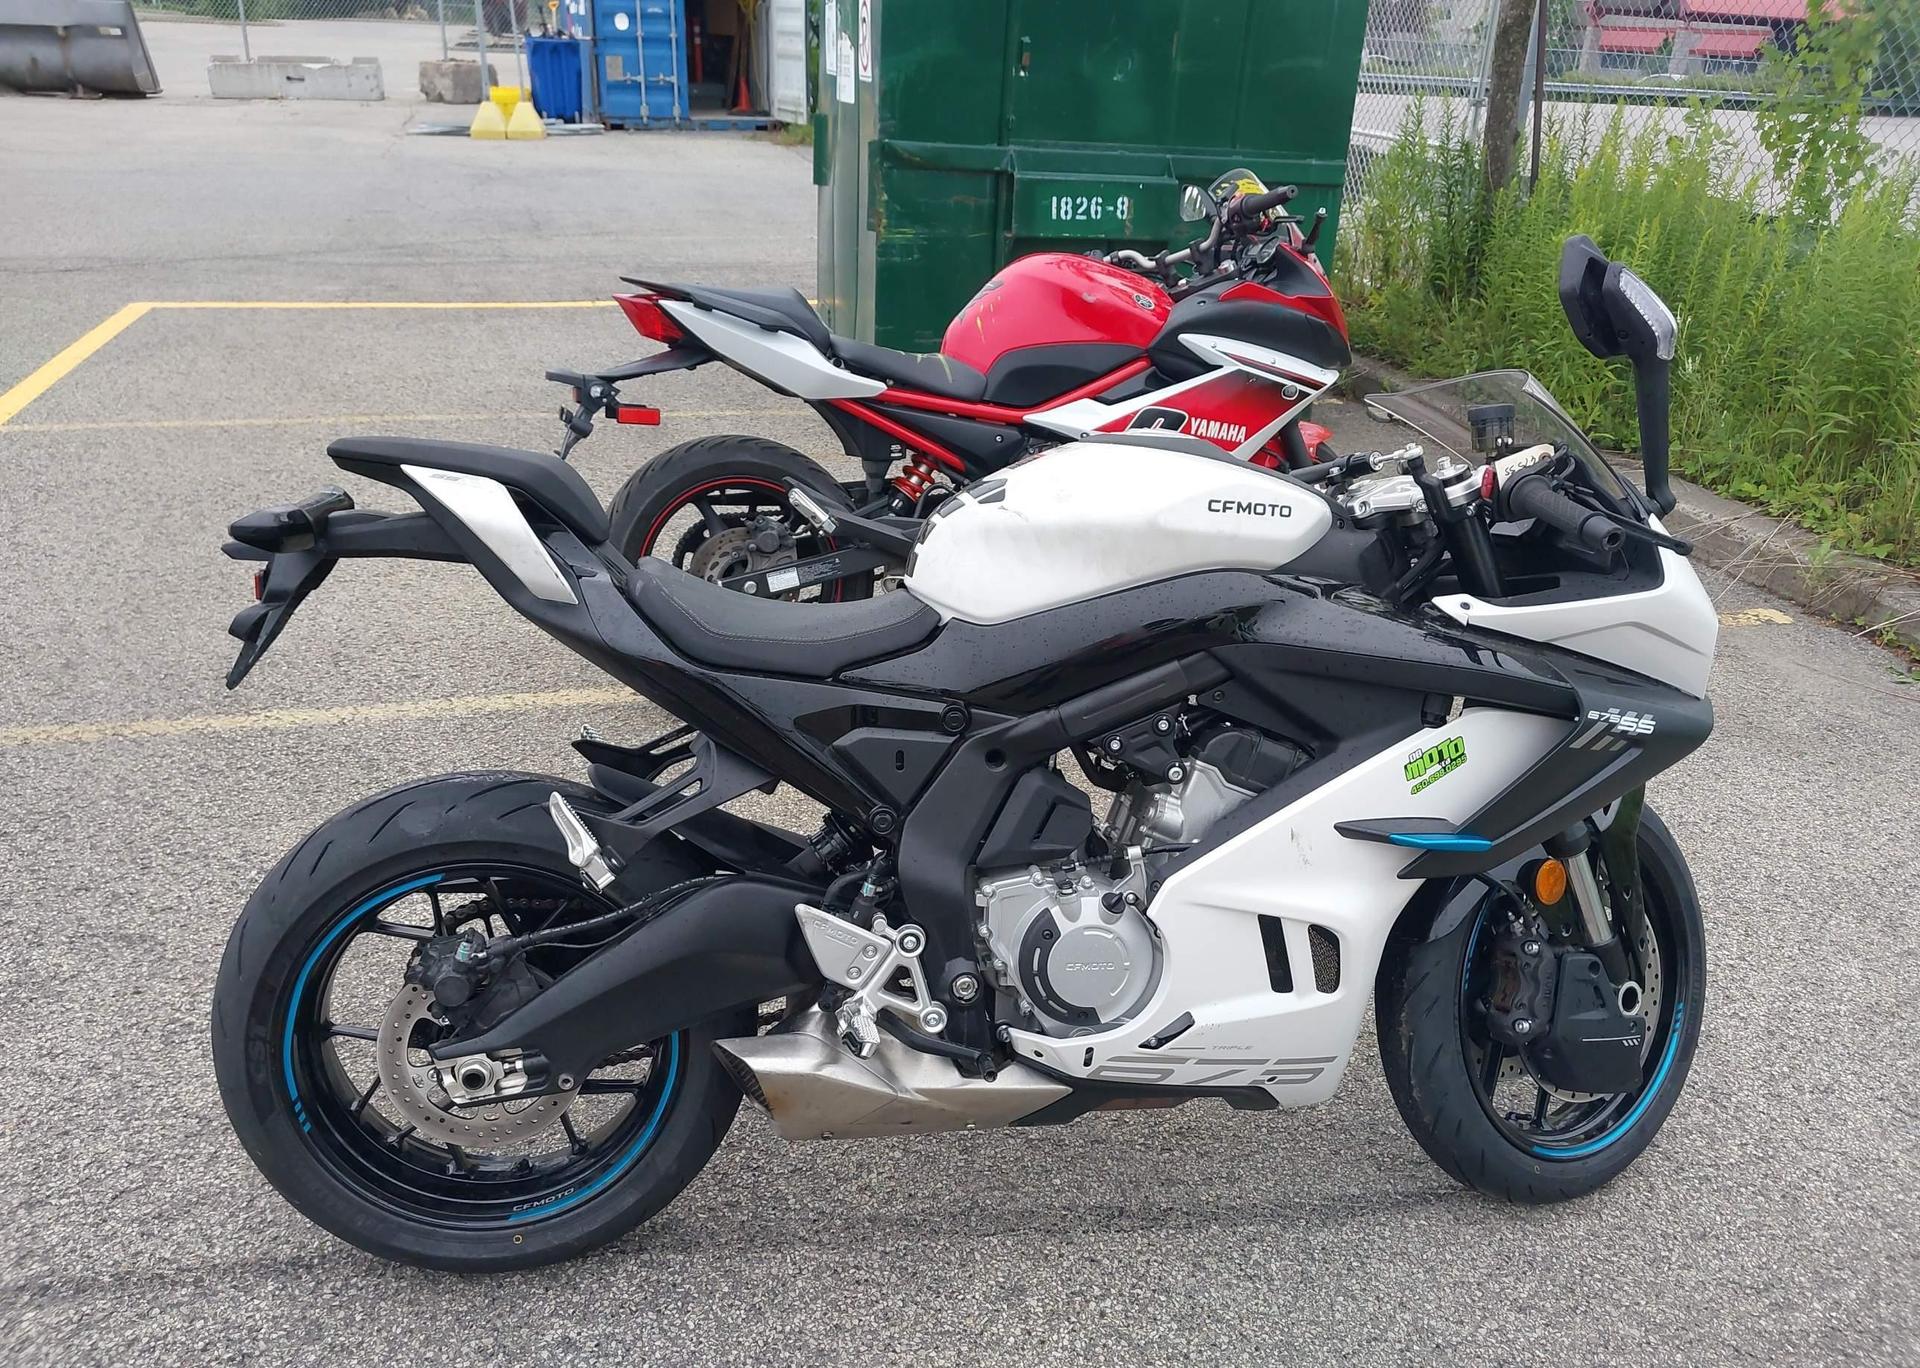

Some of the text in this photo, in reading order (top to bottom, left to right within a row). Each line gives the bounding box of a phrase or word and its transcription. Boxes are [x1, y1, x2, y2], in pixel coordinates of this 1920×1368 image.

[1051, 196, 1129, 220] 1826-8
[1190, 417, 1247, 443] YAMAHA
[1207, 499, 1292, 518] CFMOTO
[1066, 962, 1115, 971] CFMOTO
[513, 1187, 575, 1212] CFMOTO
